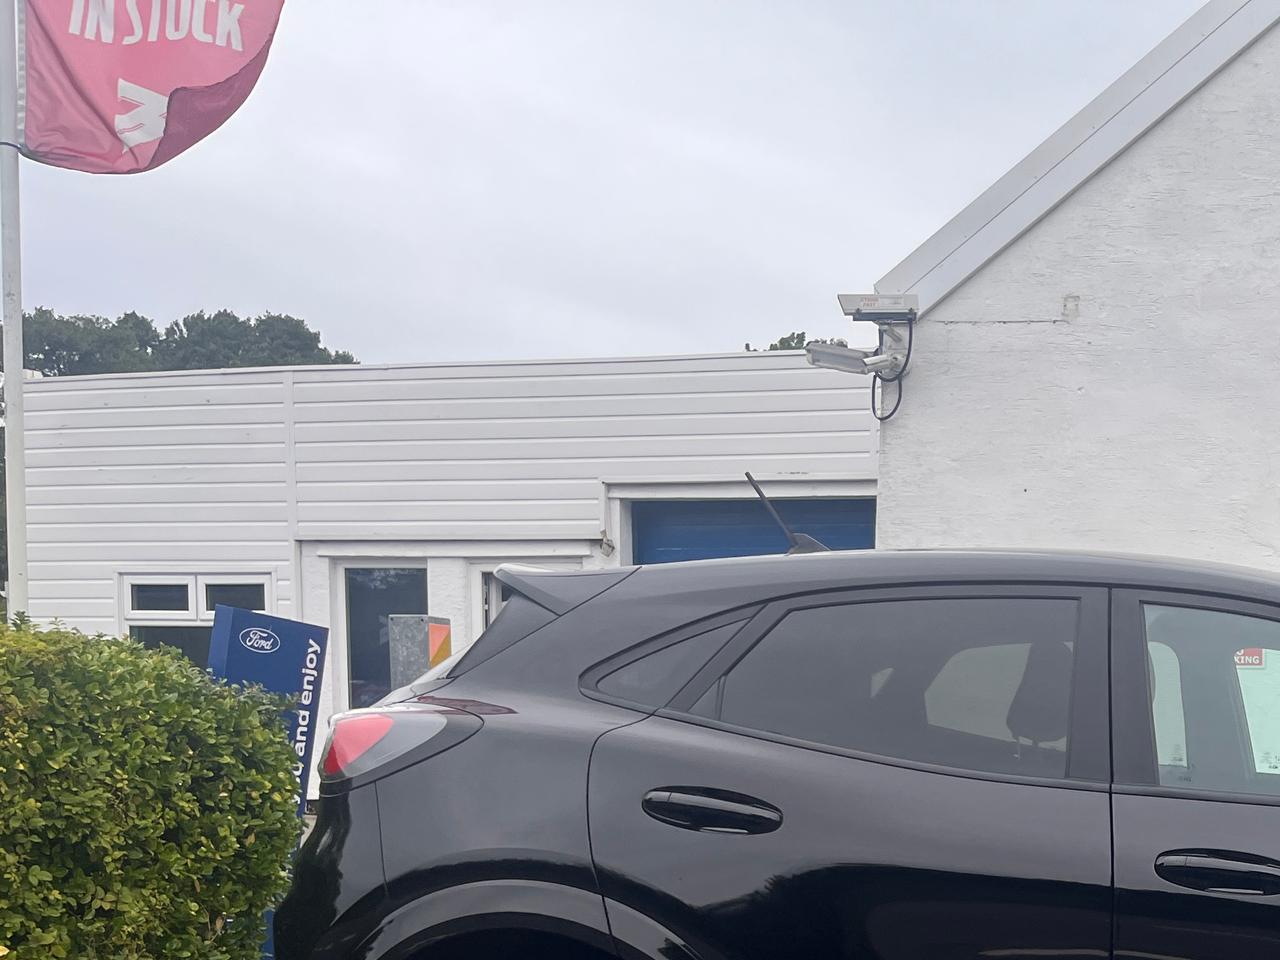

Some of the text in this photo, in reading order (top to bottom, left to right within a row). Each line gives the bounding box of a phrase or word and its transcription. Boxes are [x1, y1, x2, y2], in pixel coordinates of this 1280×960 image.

[68, 0, 116, 44] IN
[300, 638, 321, 706] enjoy
[294, 710, 311, 757] and
